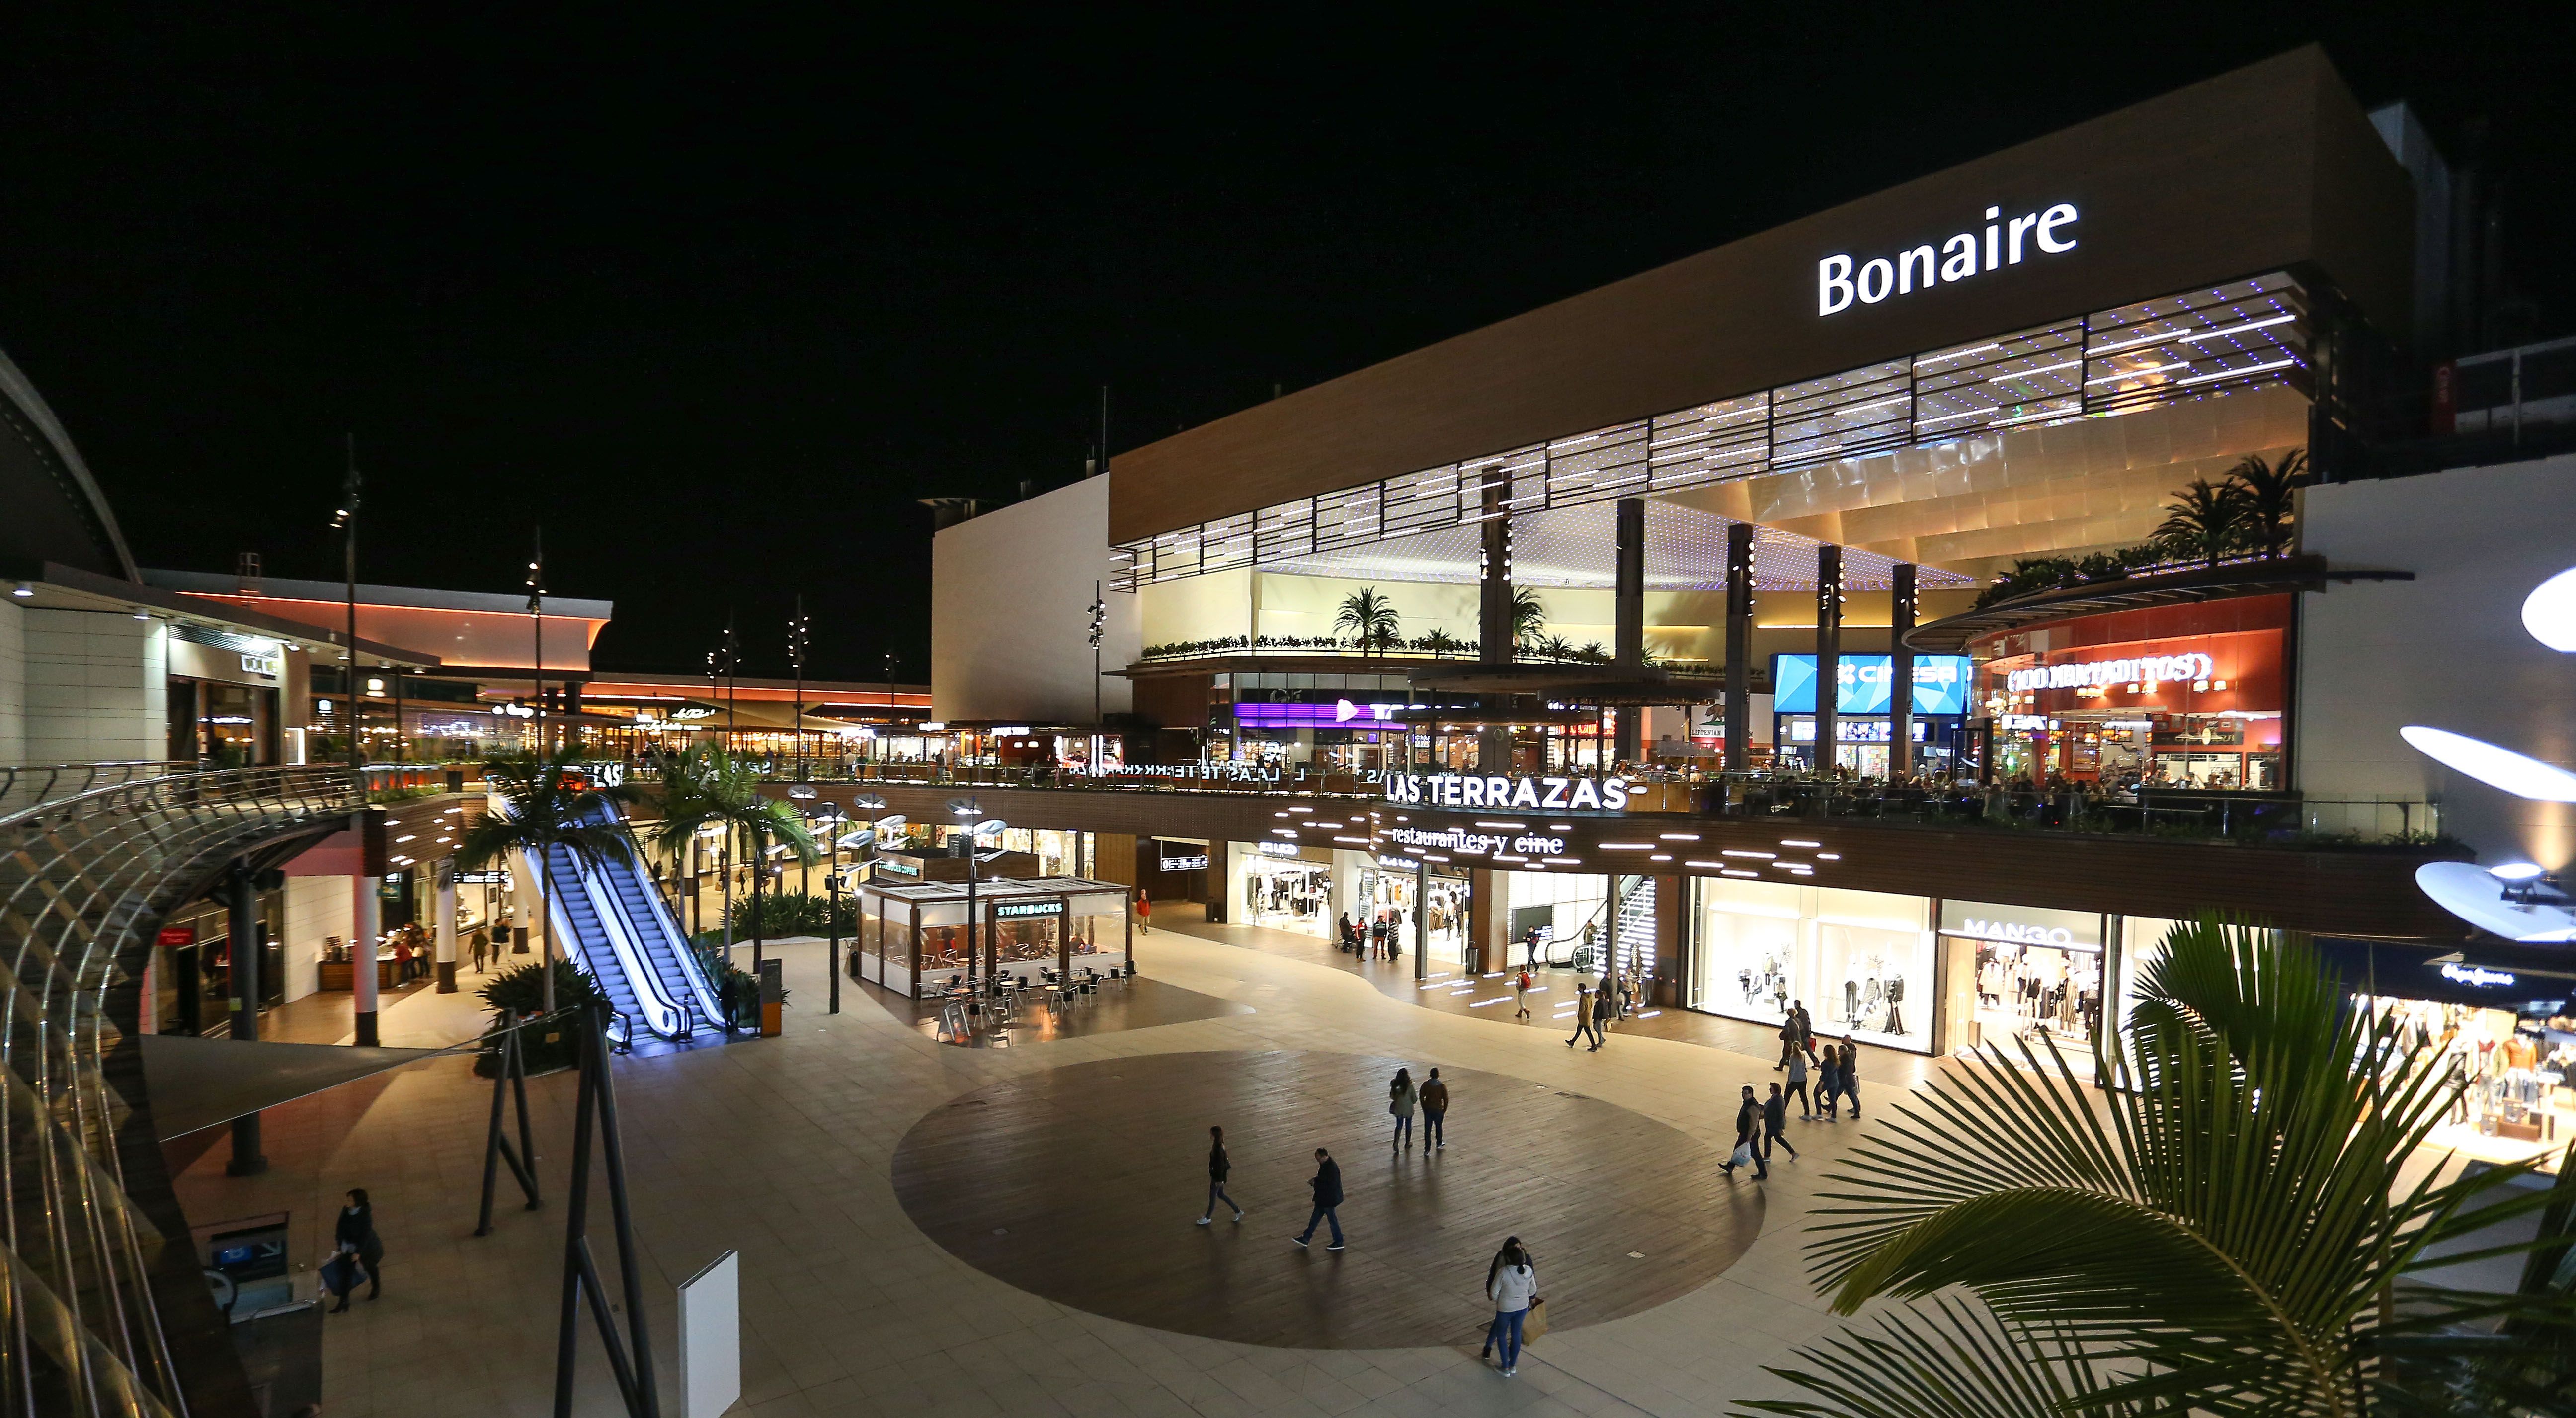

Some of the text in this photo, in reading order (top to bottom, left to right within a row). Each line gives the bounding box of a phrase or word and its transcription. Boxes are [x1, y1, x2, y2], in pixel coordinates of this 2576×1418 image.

[1819, 203, 2077, 317] Bonaire
[1858, 666, 1957, 683] CISA
[1386, 774, 1420, 803] LAS
[1427, 776, 1628, 809] TERRAZAS
[1392, 827, 1564, 856] restaurantes y cine
[998, 903, 1062, 916] STARBUCKS
[1964, 918, 2072, 944] MANGO
